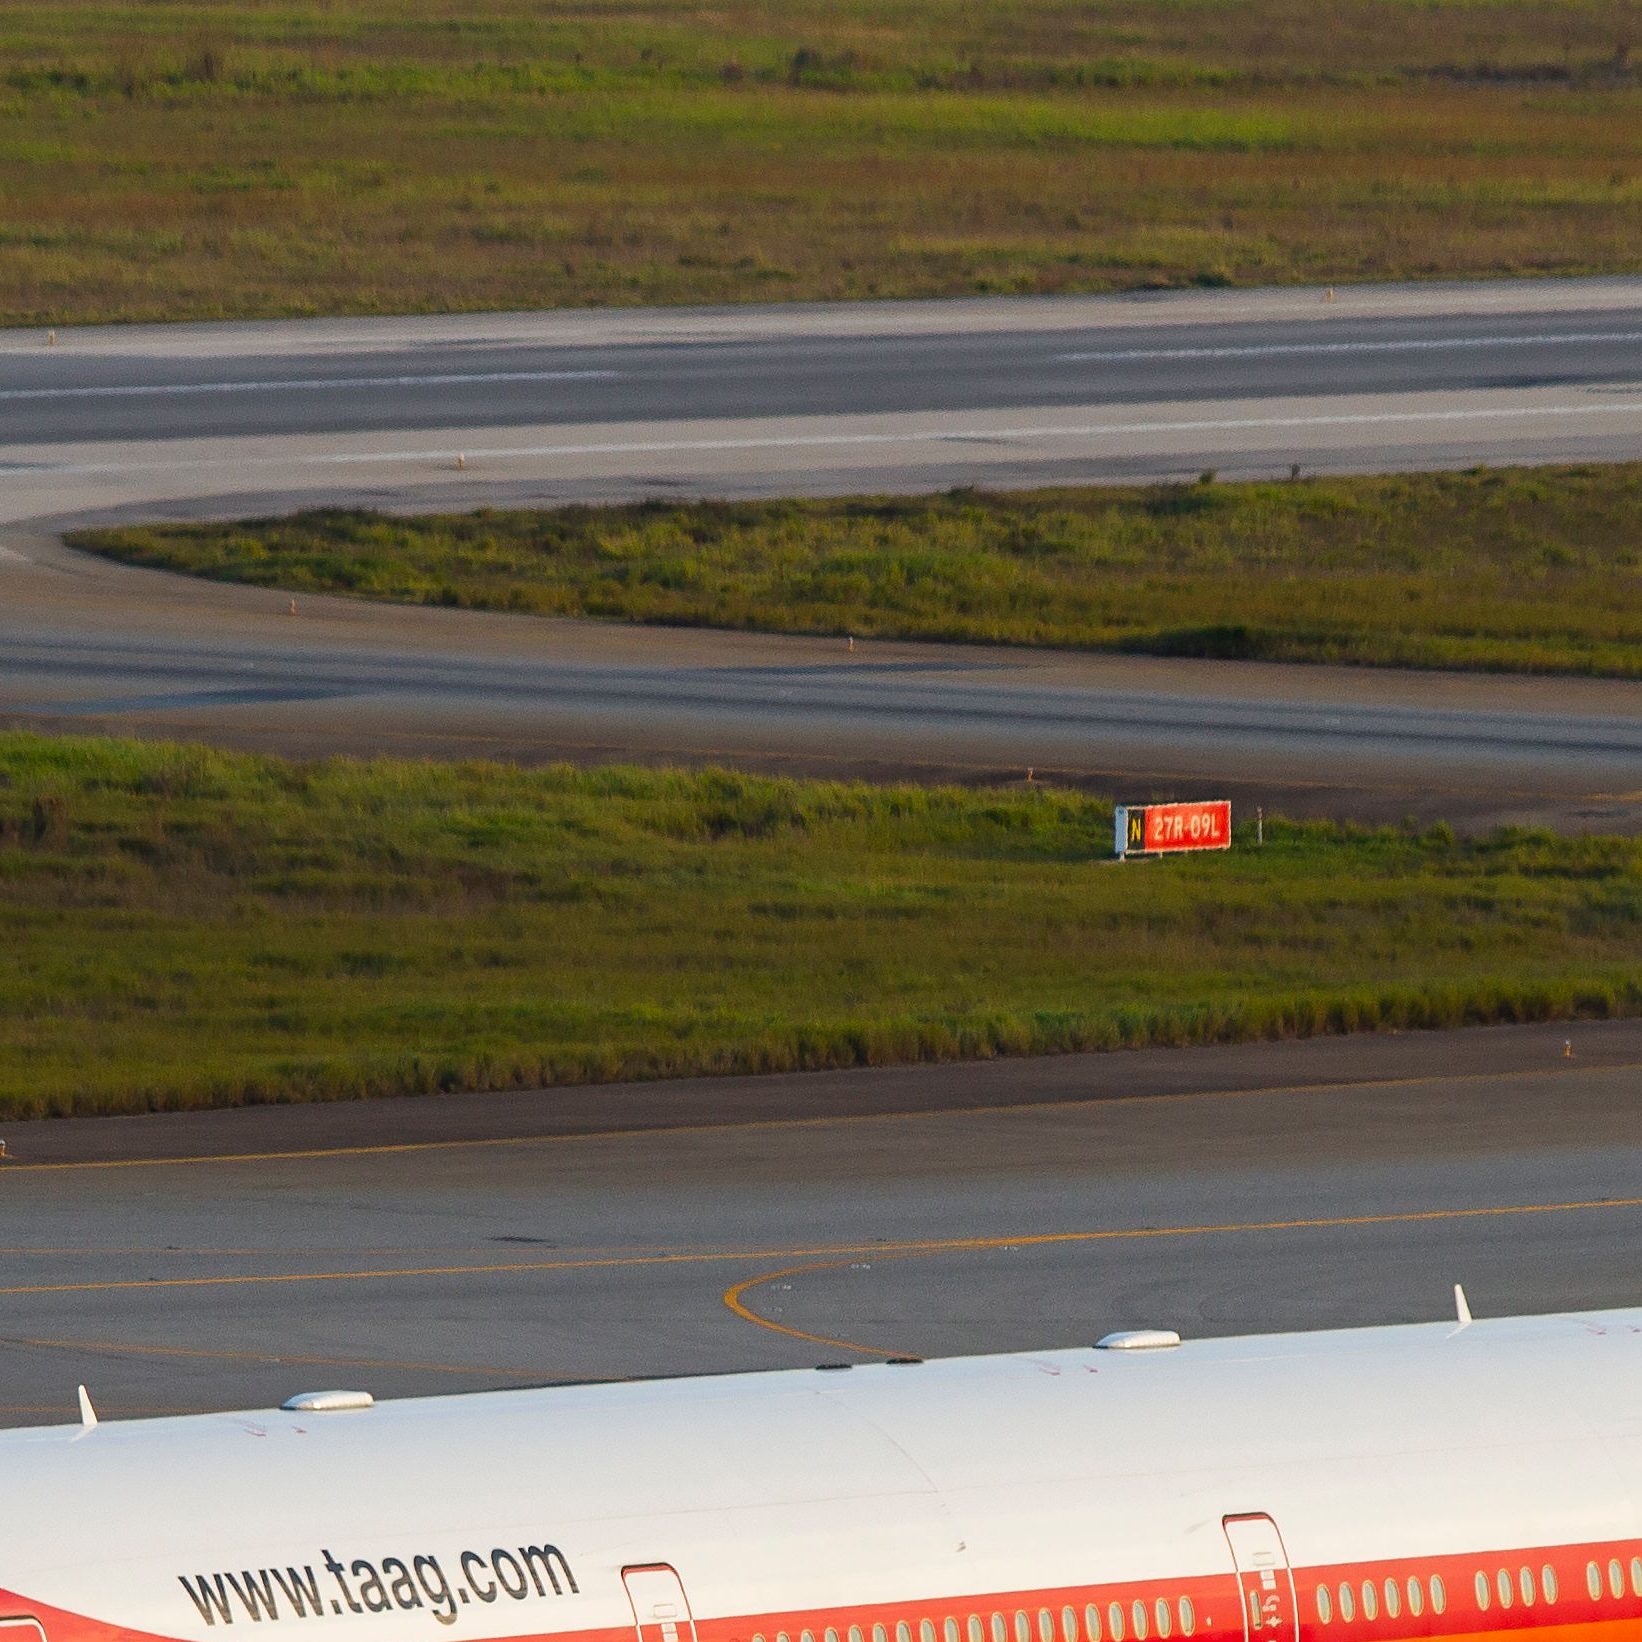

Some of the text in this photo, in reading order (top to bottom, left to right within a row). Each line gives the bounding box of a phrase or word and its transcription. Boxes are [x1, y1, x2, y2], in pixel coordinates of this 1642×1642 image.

[1130, 813, 1220, 841] N 27R-09L
[178, 1542, 580, 1626] www.taag.com
